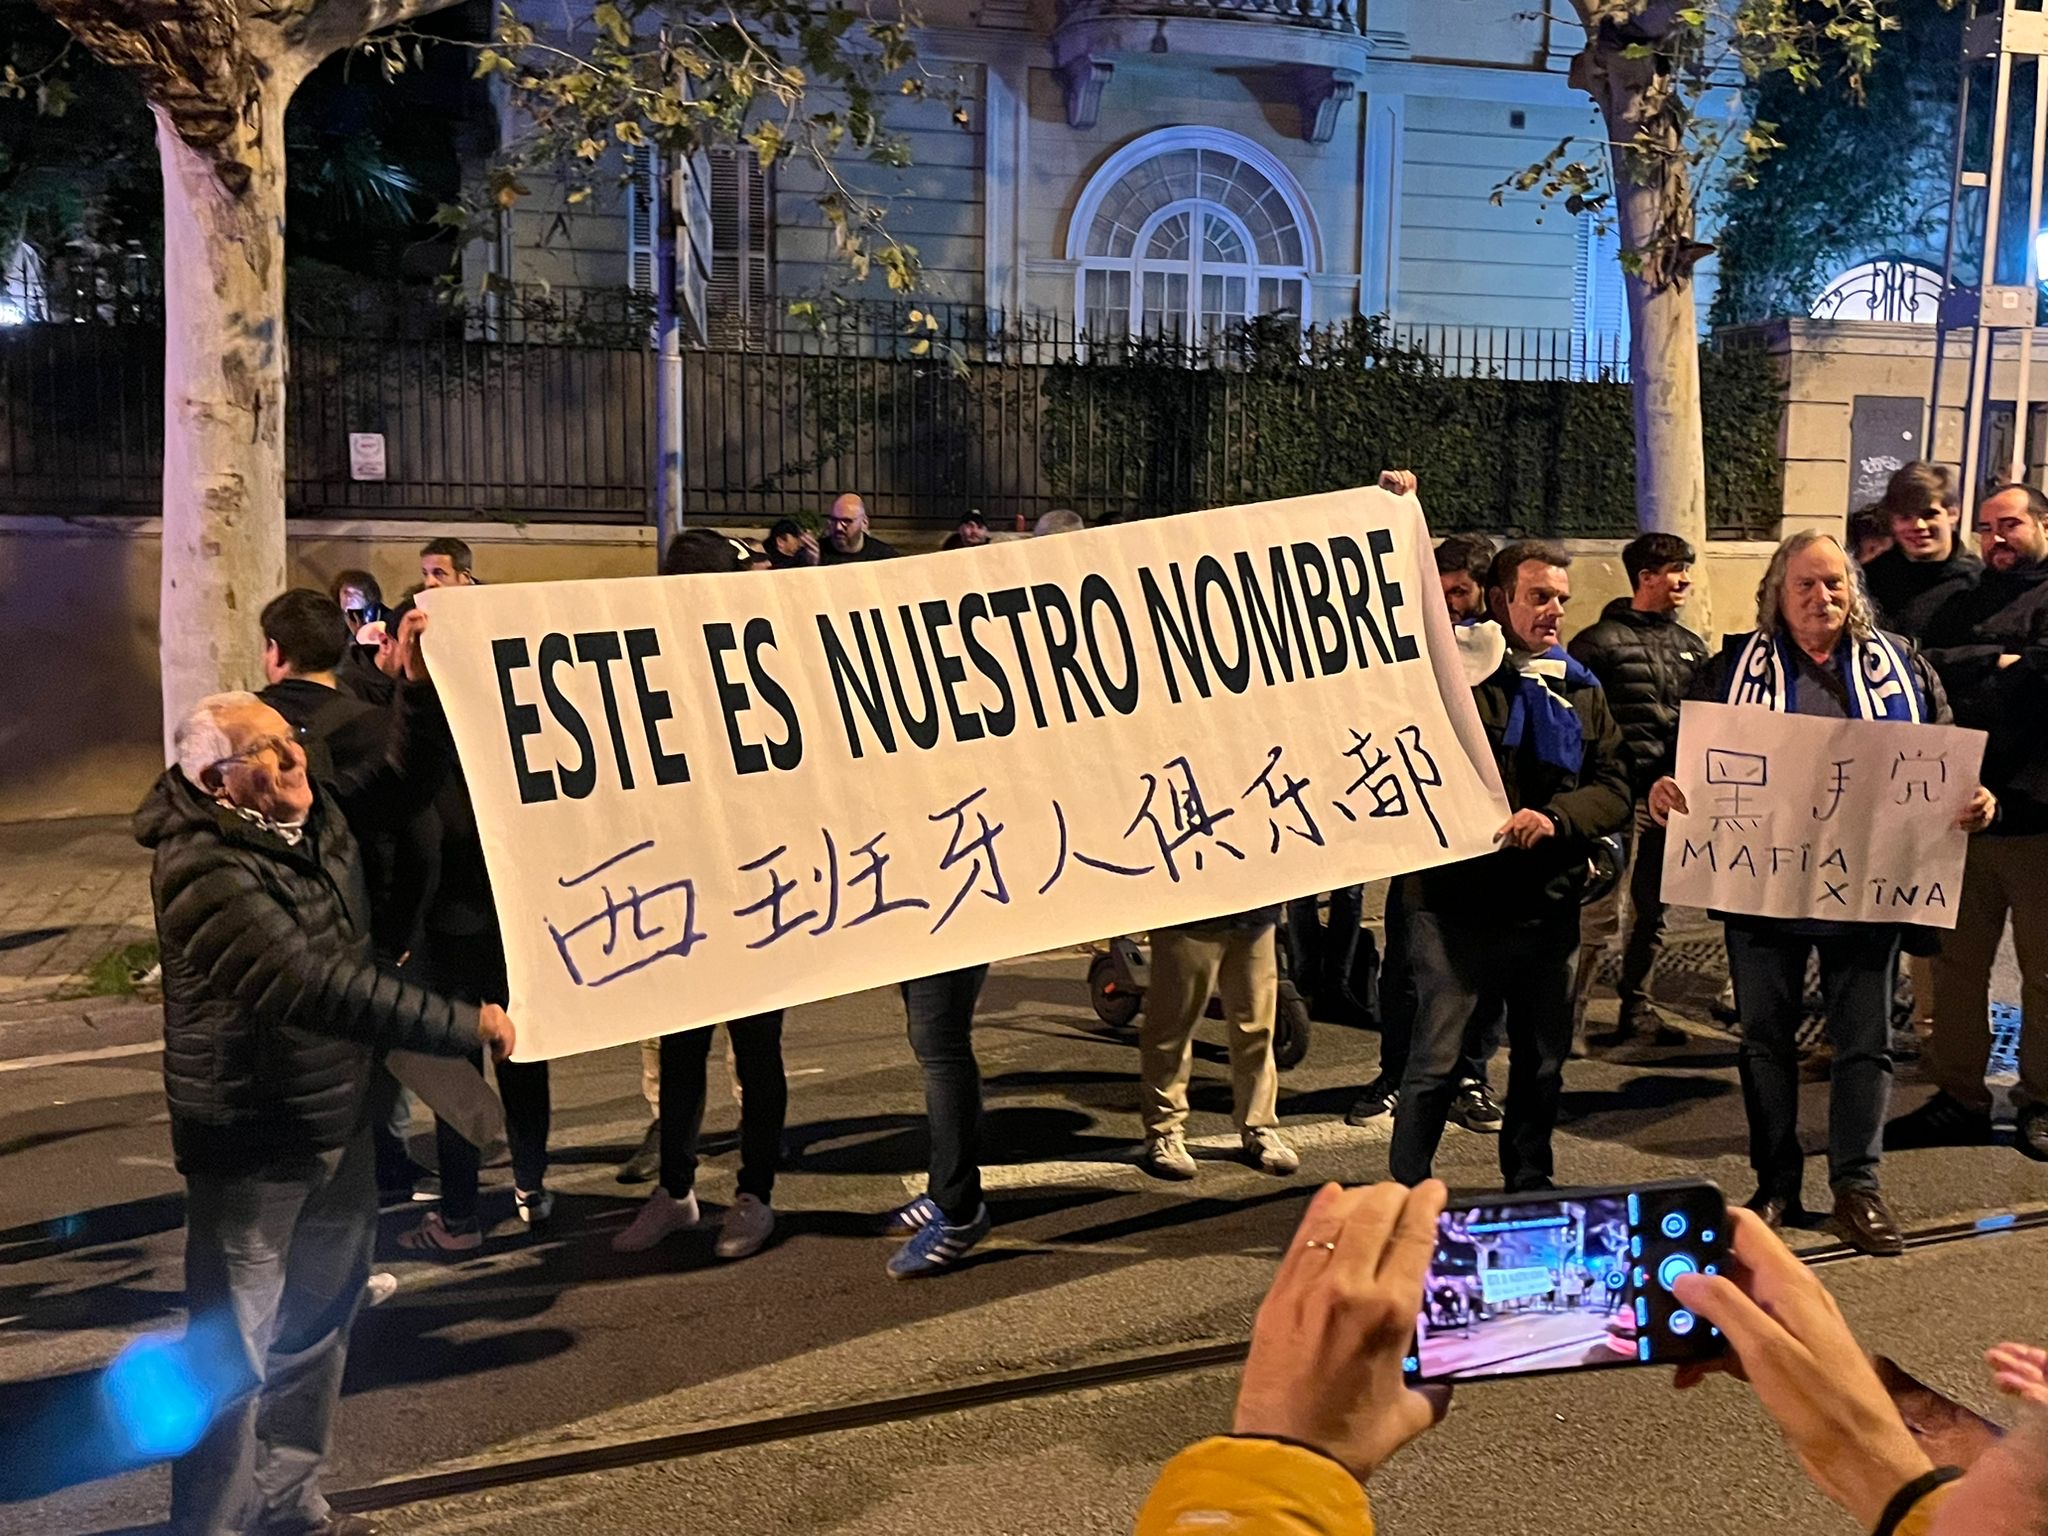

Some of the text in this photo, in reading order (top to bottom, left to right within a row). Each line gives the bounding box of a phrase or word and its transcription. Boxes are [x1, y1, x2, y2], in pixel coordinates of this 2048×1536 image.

[491, 528, 1421, 805] ESTE ES NUESTRO NOMBRE
